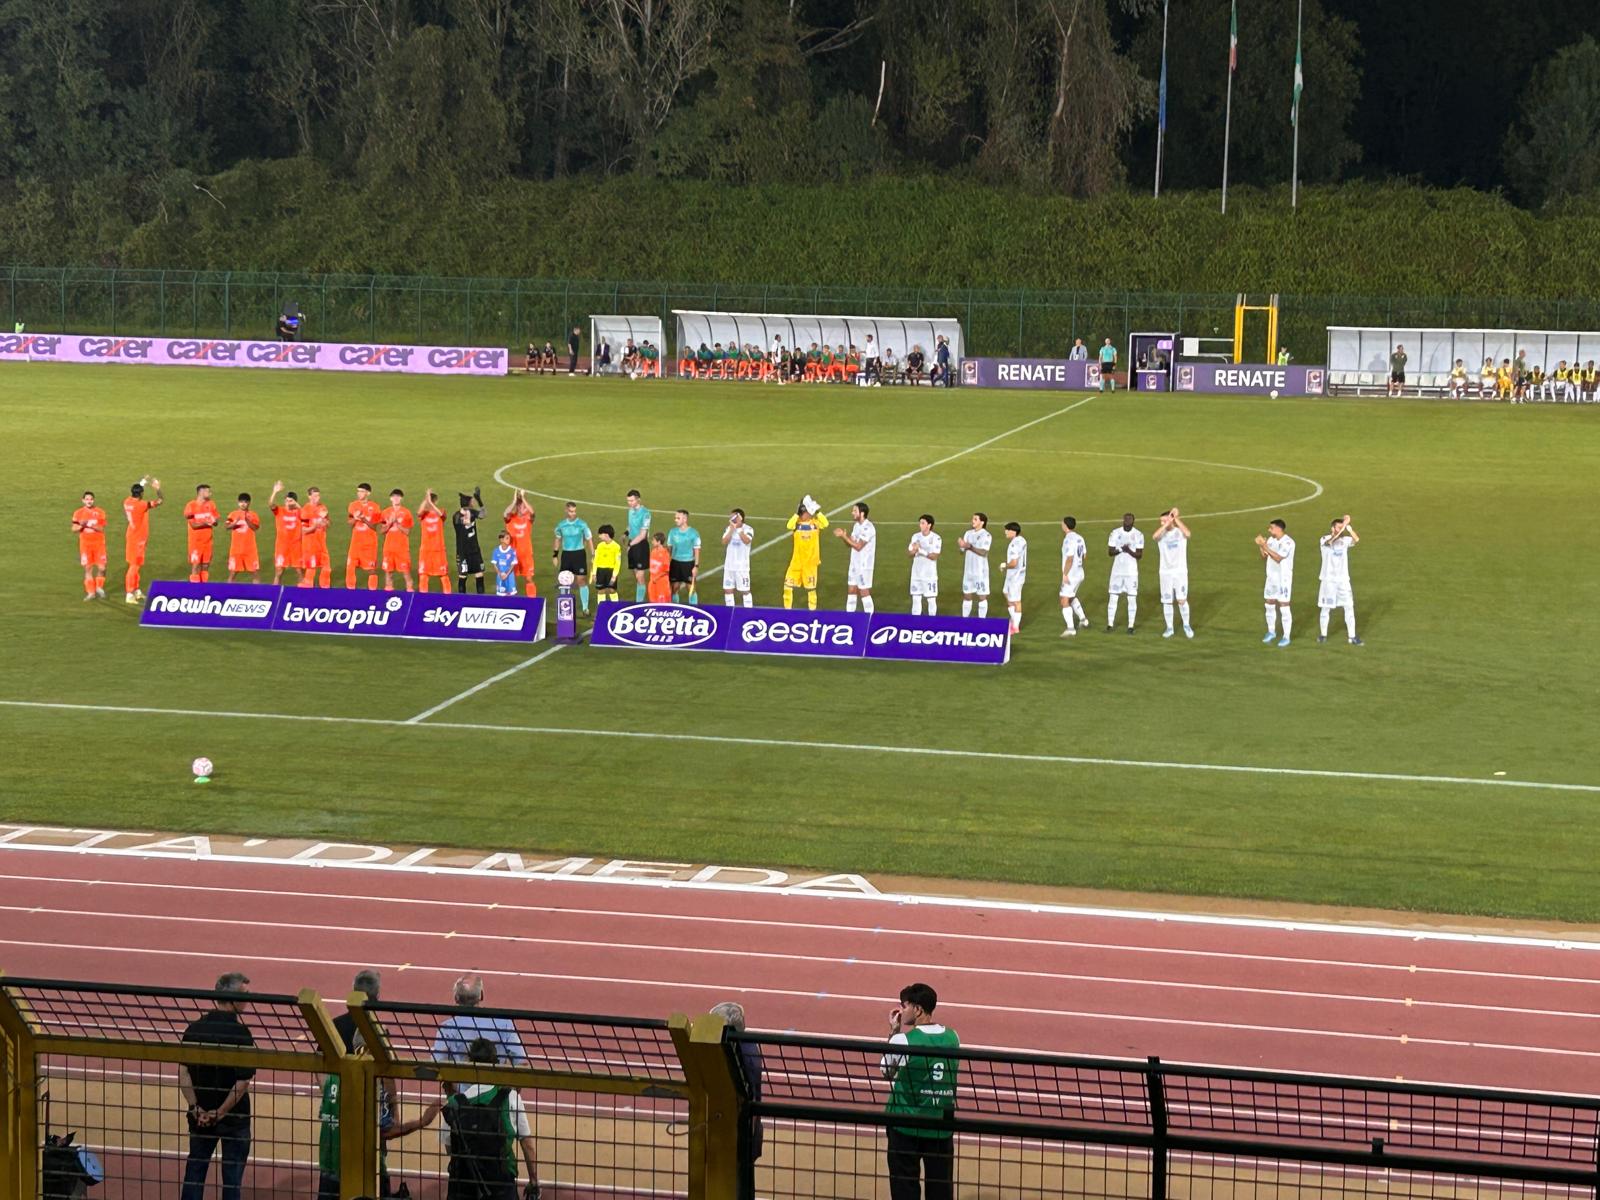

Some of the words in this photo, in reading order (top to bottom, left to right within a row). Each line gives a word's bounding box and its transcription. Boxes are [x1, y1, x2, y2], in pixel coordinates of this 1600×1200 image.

[0, 334, 61, 354] arer
[78, 337, 152, 358] carer
[166, 341, 241, 361] carer
[246, 343, 321, 363] carer
[339, 345, 414, 366] carer
[427, 348, 504, 369] carer
[998, 364, 1065, 381] RENATE
[1214, 369, 1286, 387] RENATE
[226, 603, 267, 613] NEWS
[422, 607, 458, 626] sky
[464, 610, 498, 624] wifi
[612, 613, 709, 636] Beretta
[768, 619, 854, 646] estra
[899, 630, 1004, 648] DECATHLON
[470, 852, 882, 896] MEDA
